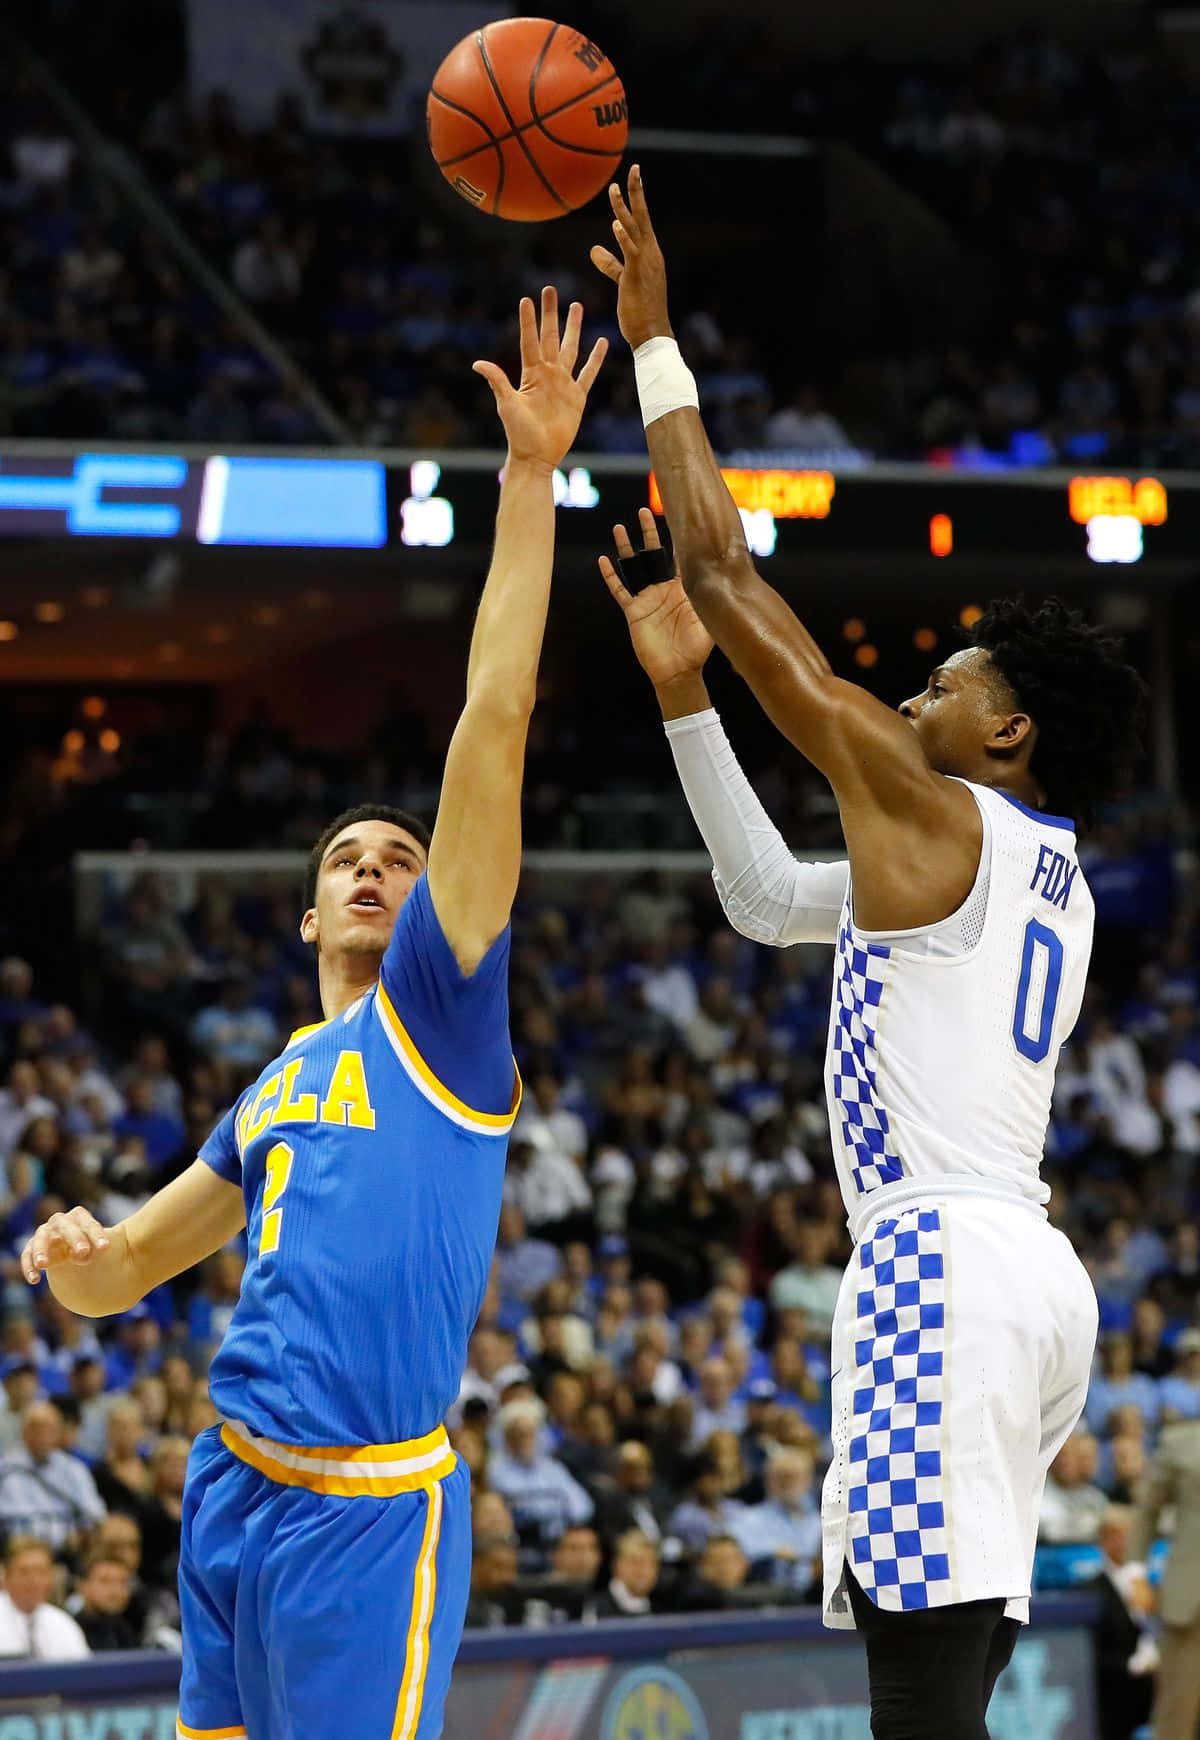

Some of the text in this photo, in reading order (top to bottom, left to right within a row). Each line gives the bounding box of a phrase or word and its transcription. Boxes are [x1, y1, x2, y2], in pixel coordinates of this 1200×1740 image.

[1029, 843, 1078, 911] FOX
[1011, 915, 1065, 1065] 0
[259, 1141, 295, 1257] 2
